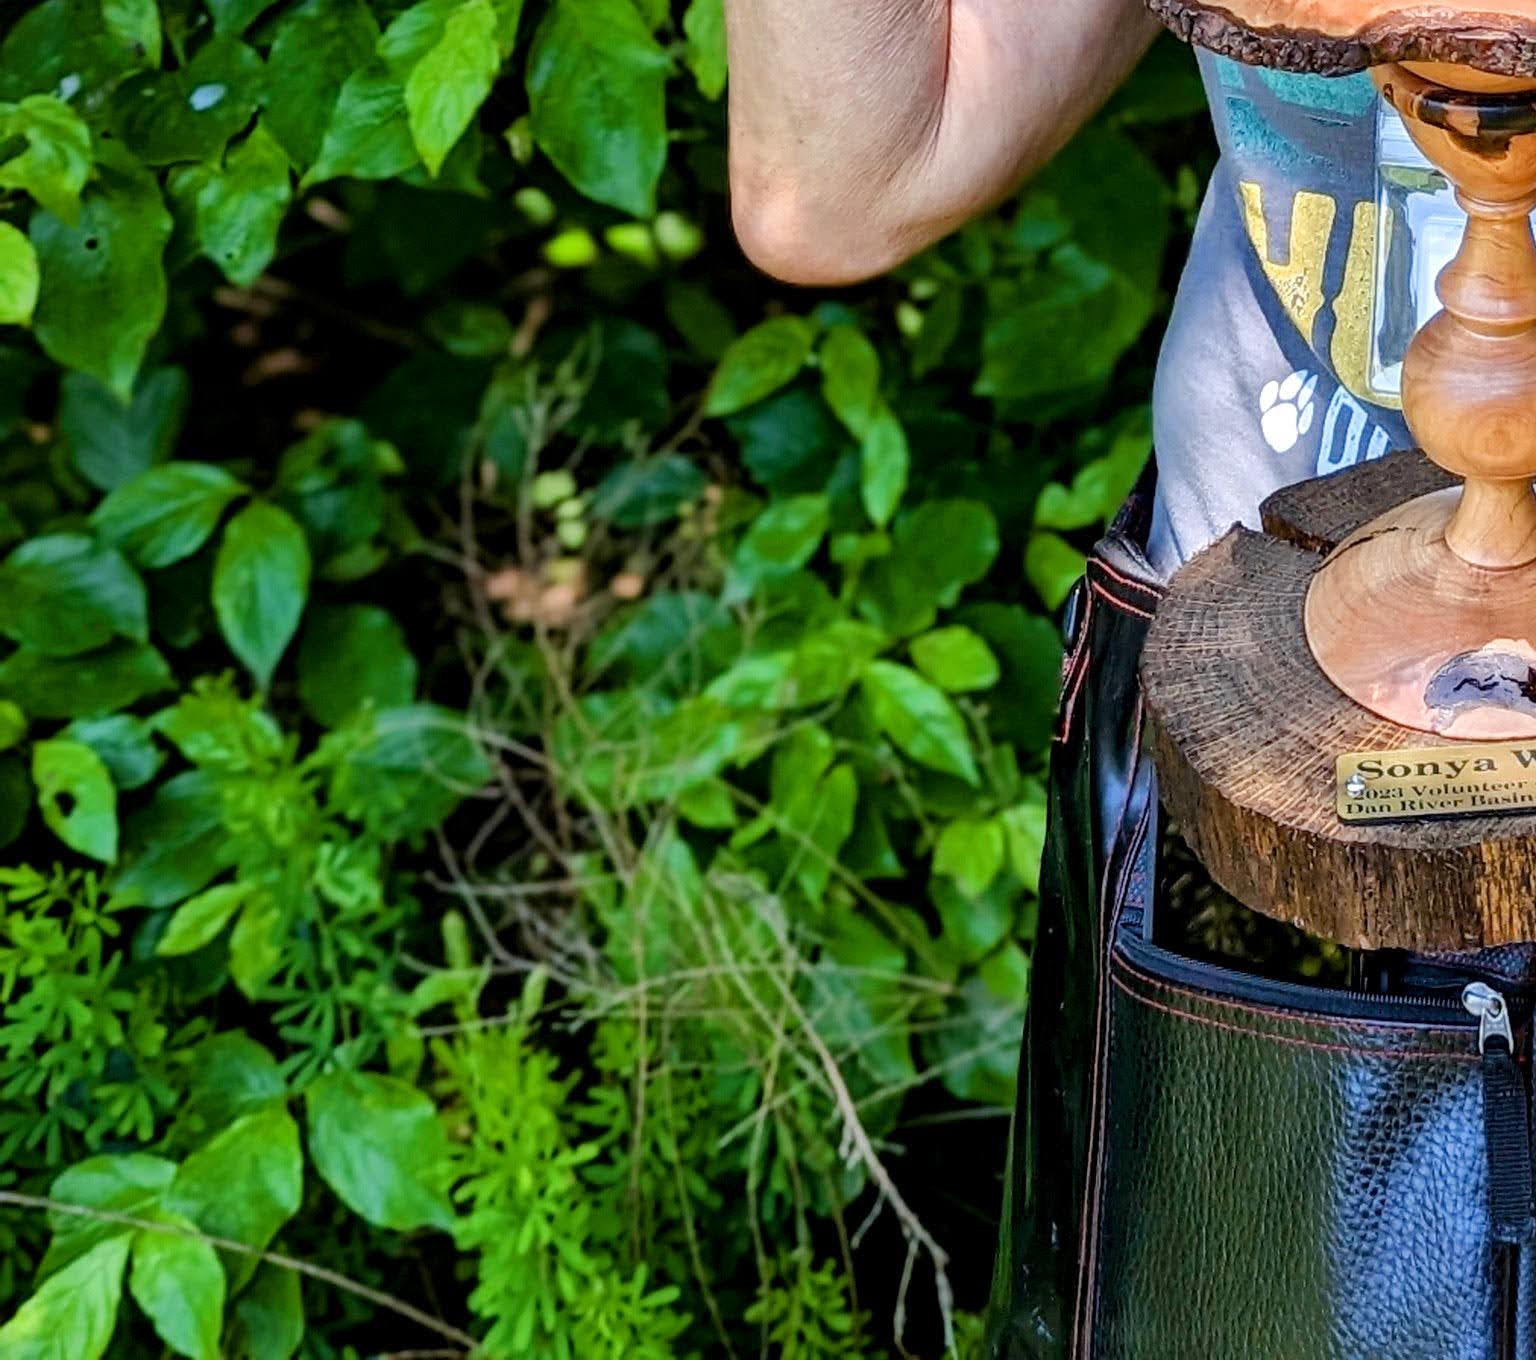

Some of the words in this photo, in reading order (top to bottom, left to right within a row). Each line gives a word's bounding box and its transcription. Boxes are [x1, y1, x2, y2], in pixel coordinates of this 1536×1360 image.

[1357, 757, 1497, 780] Sonya
[1411, 781, 1528, 798] Volunteer
[1346, 803, 1391, 815] Dan
[1400, 798, 1463, 811] River
[1471, 794, 1533, 807] Basin
